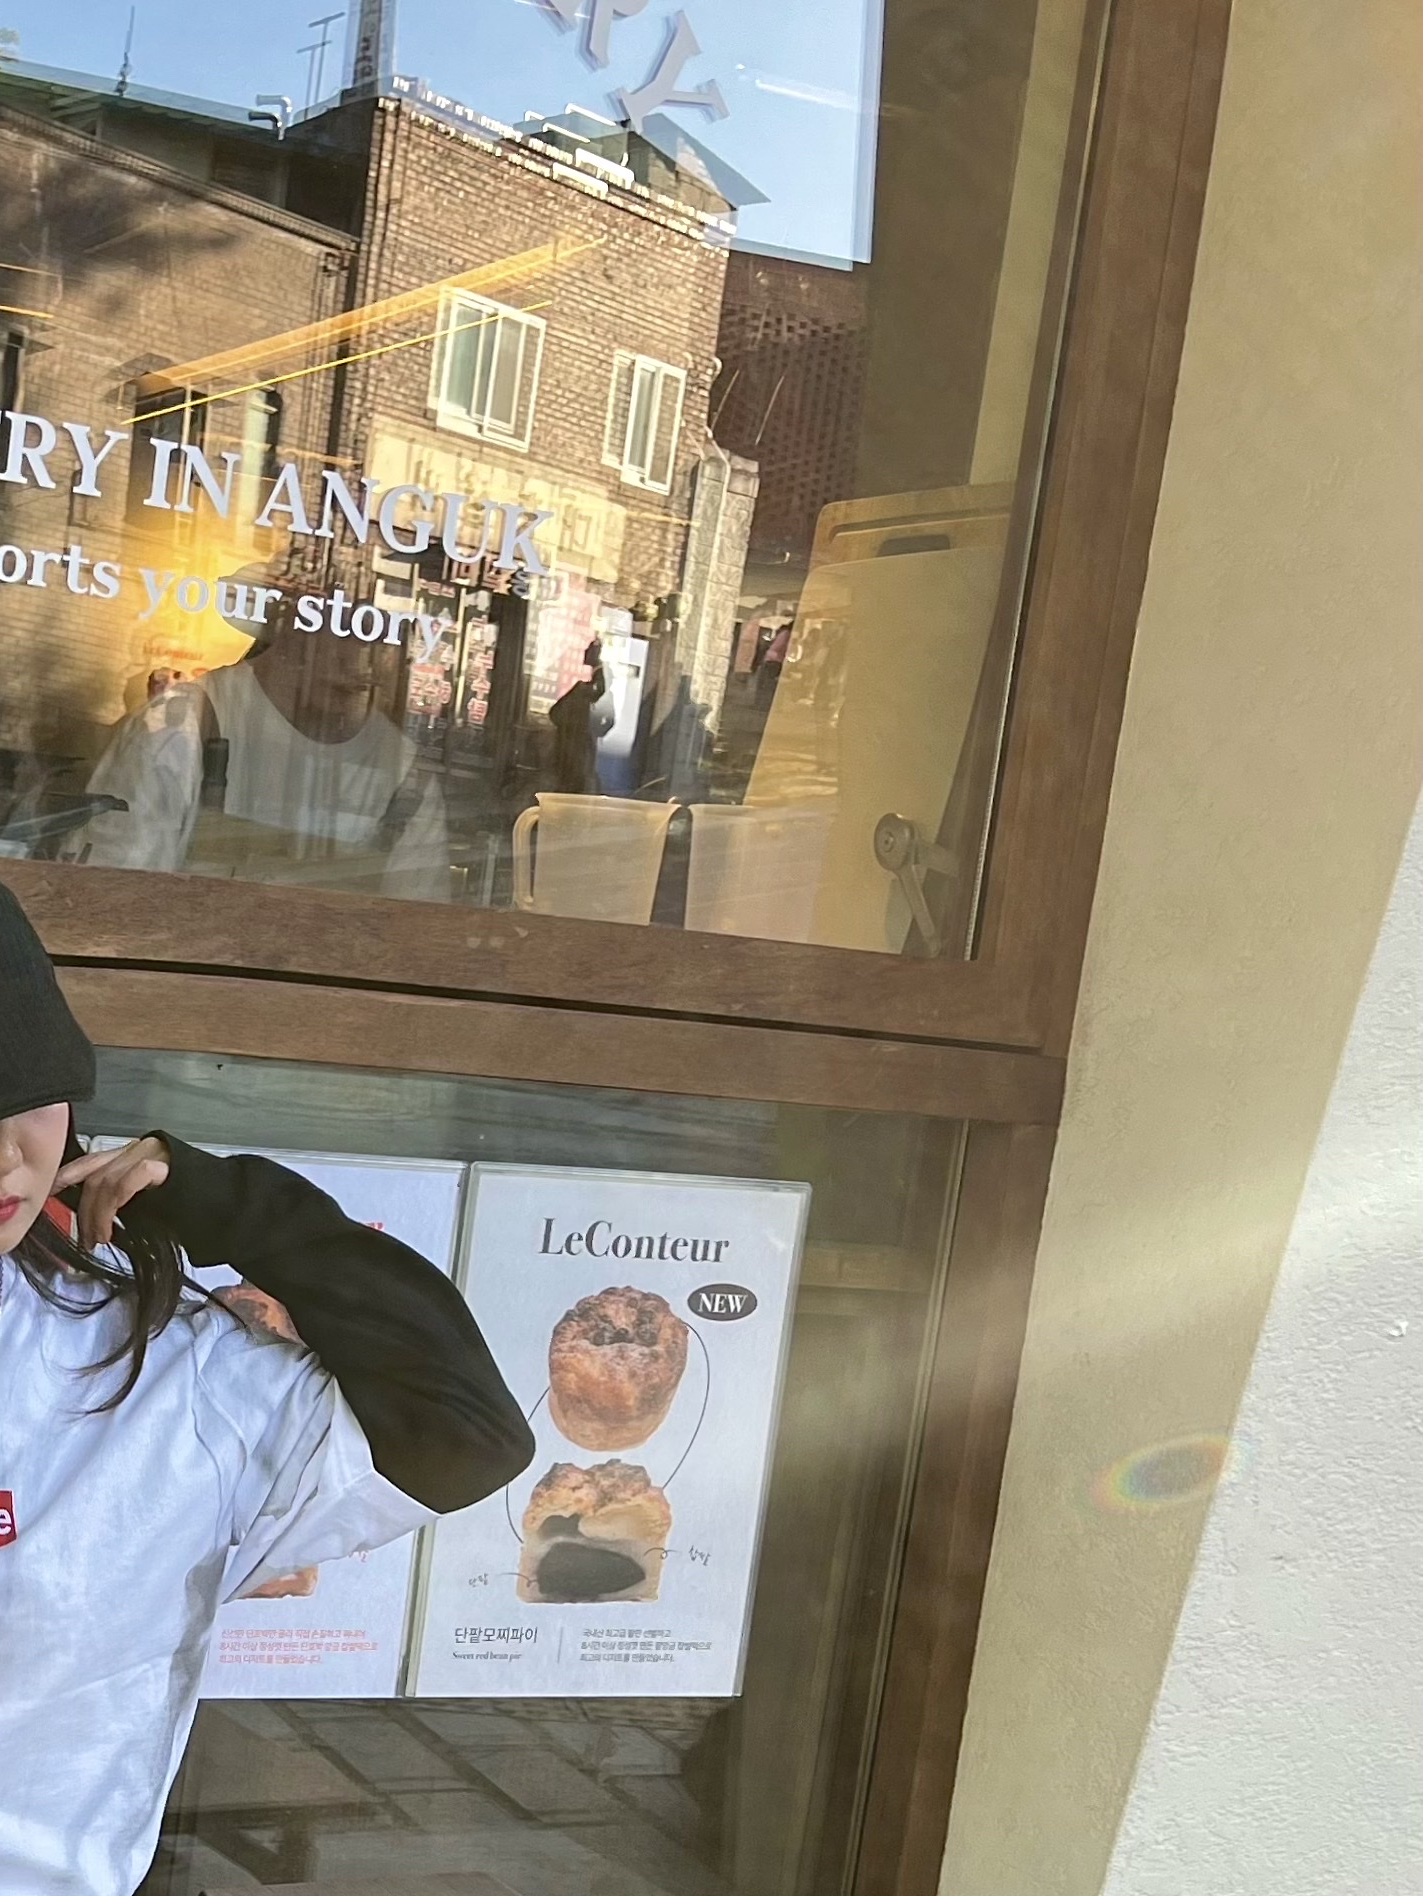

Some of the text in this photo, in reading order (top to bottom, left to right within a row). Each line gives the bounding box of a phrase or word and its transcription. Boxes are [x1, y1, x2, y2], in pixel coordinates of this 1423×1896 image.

[143, 437, 240, 518] IN
[254, 463, 557, 576] ANGUK
[136, 568, 283, 623] your
[293, 579, 458, 663] story
[538, 1218, 730, 1263] LeConteur
[698, 1293, 747, 1313] NEW
